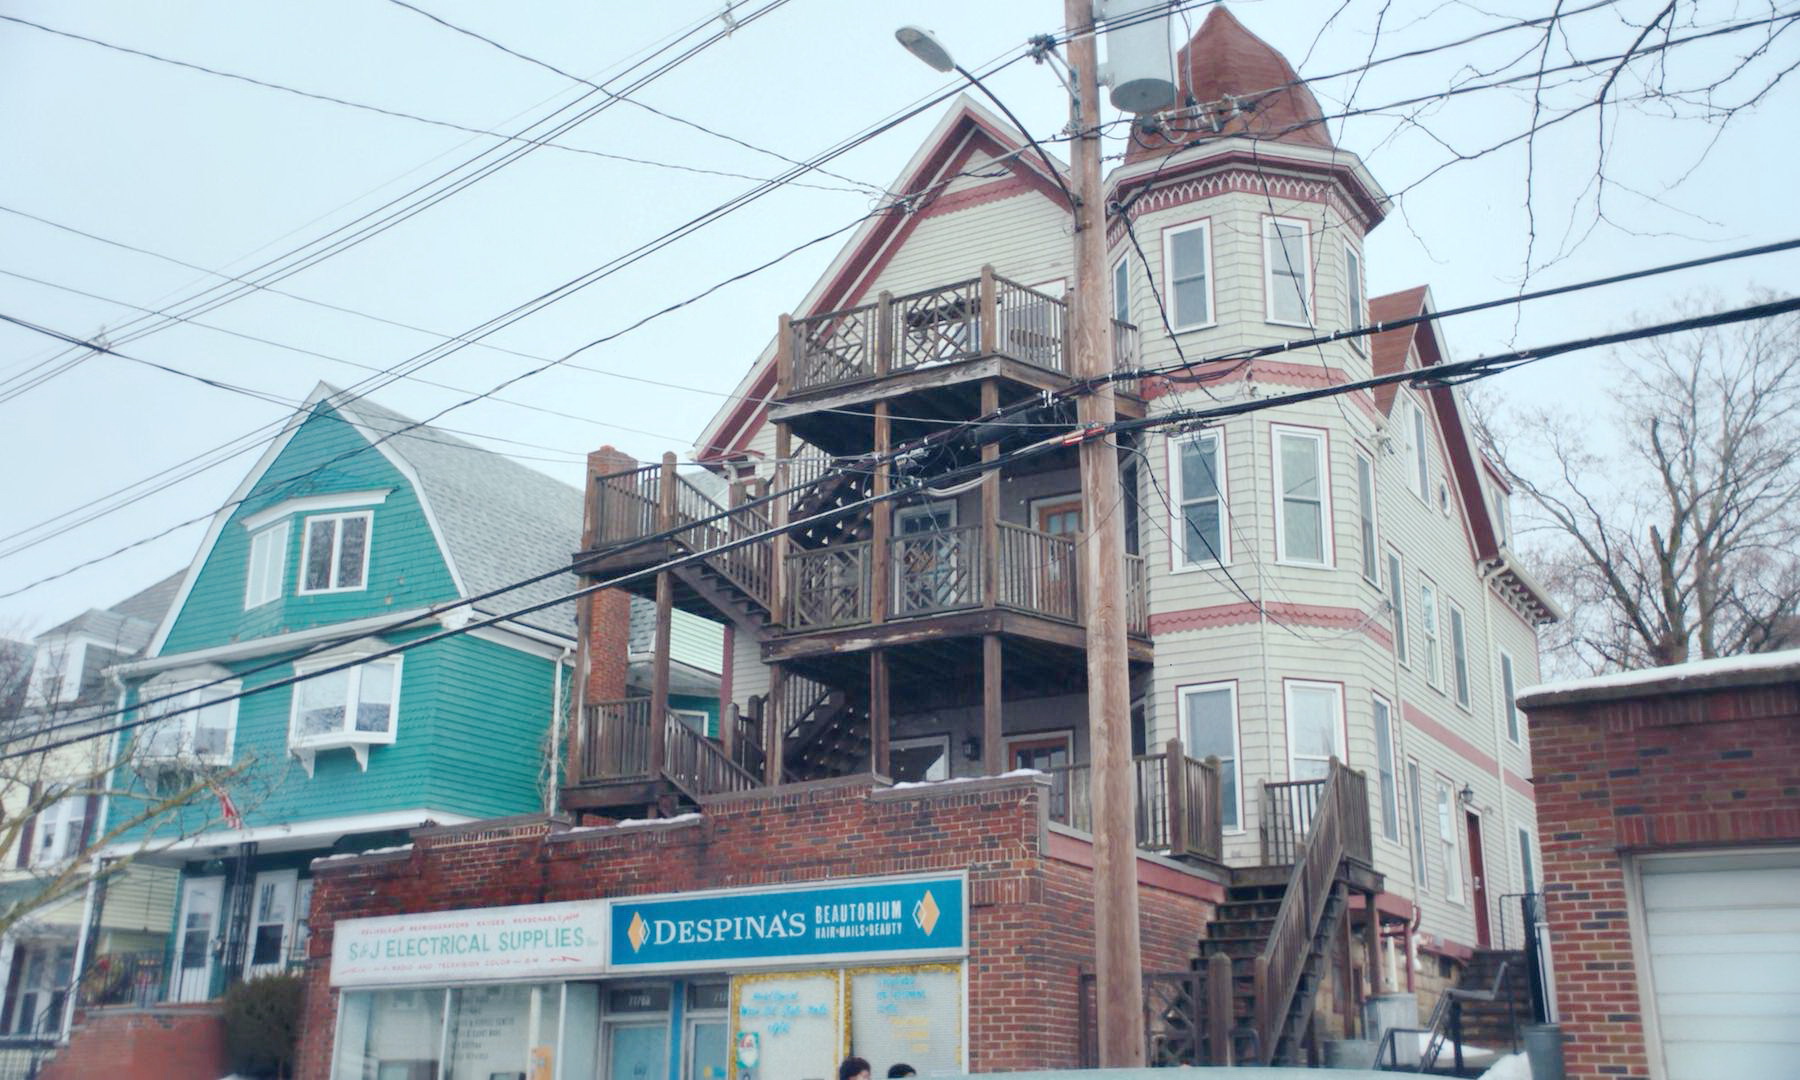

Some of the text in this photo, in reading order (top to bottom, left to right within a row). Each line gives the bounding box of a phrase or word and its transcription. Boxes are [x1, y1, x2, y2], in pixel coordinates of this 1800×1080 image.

[654, 909, 805, 945] DESPINA'S
[815, 900, 902, 923] BEAUTORIUM
[386, 934, 490, 958] ELECTRICAL
[499, 927, 584, 951] SUPPLIES
